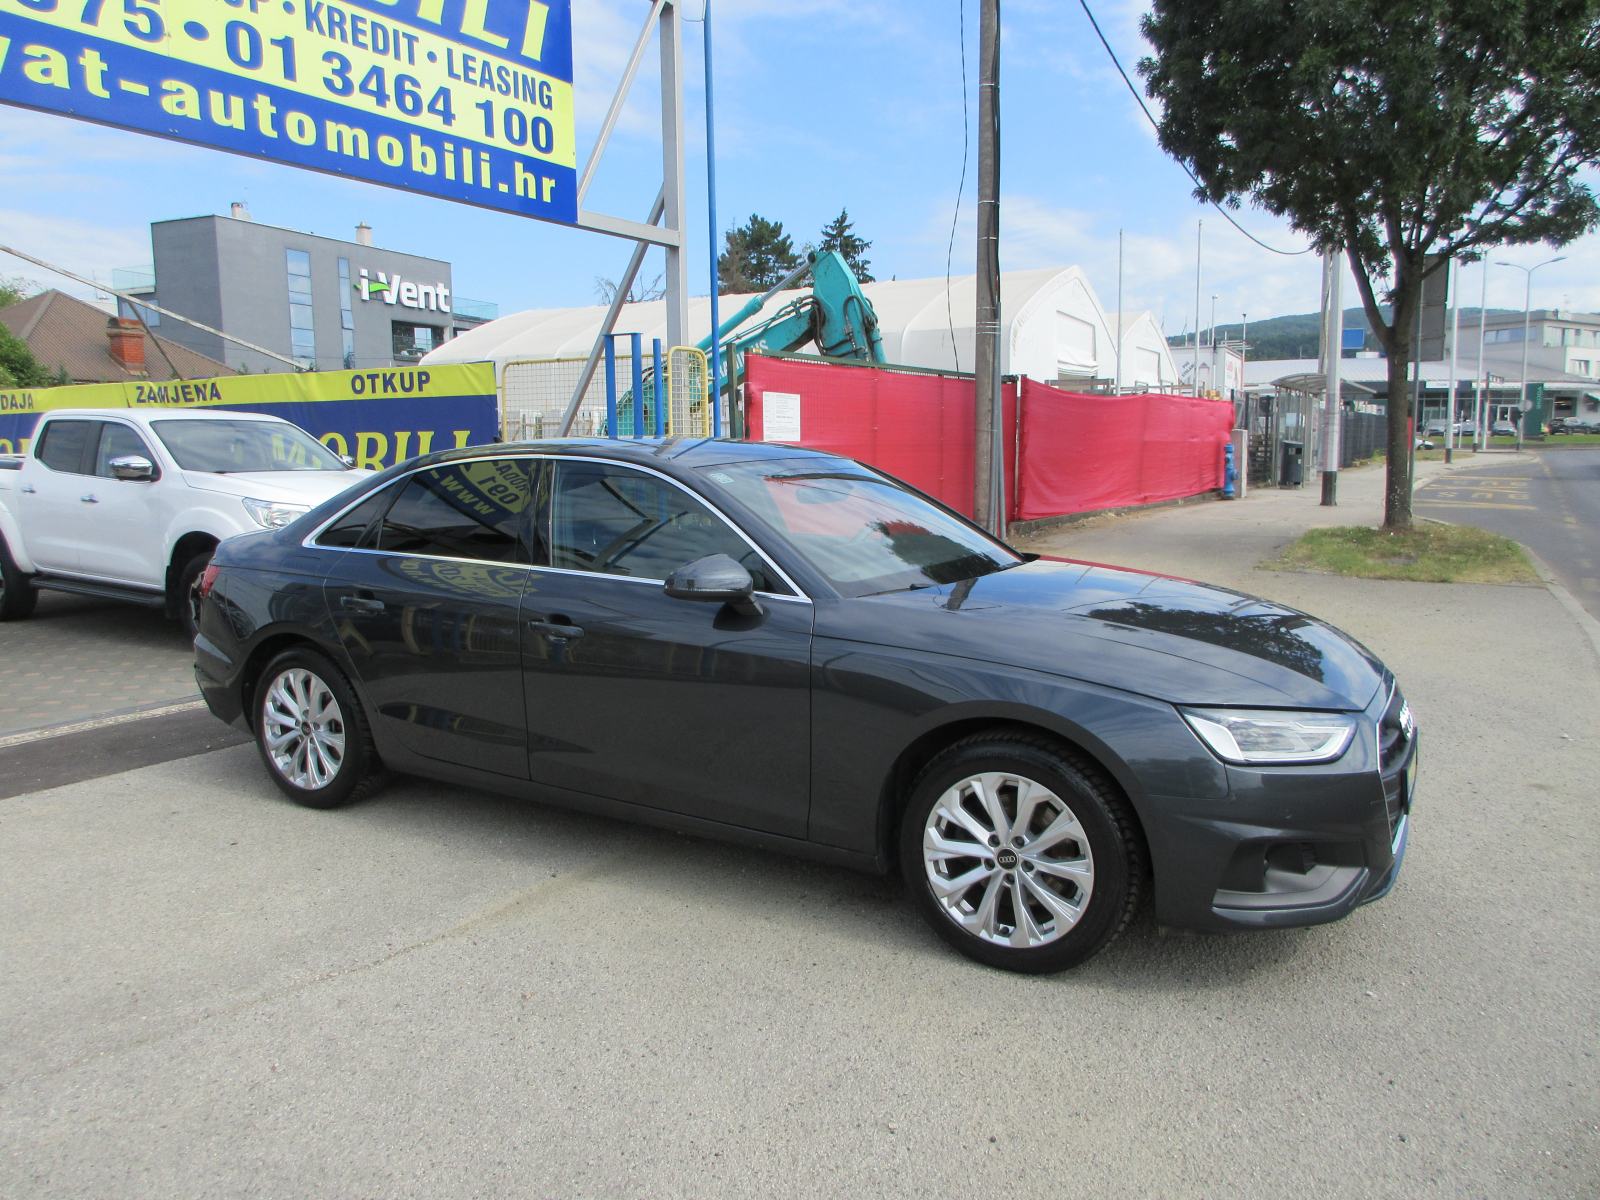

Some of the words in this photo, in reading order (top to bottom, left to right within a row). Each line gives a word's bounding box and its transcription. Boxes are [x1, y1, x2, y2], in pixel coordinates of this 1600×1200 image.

[225, 19, 298, 83] 01
[321, 50, 456, 127] 3464
[475, 98, 554, 155] 100
[304, 0, 420, 67] KREDIT
[445, 47, 553, 112] LEASING
[135, 382, 223, 404] ZAMJENA
[351, 371, 430, 394] OTKUP
